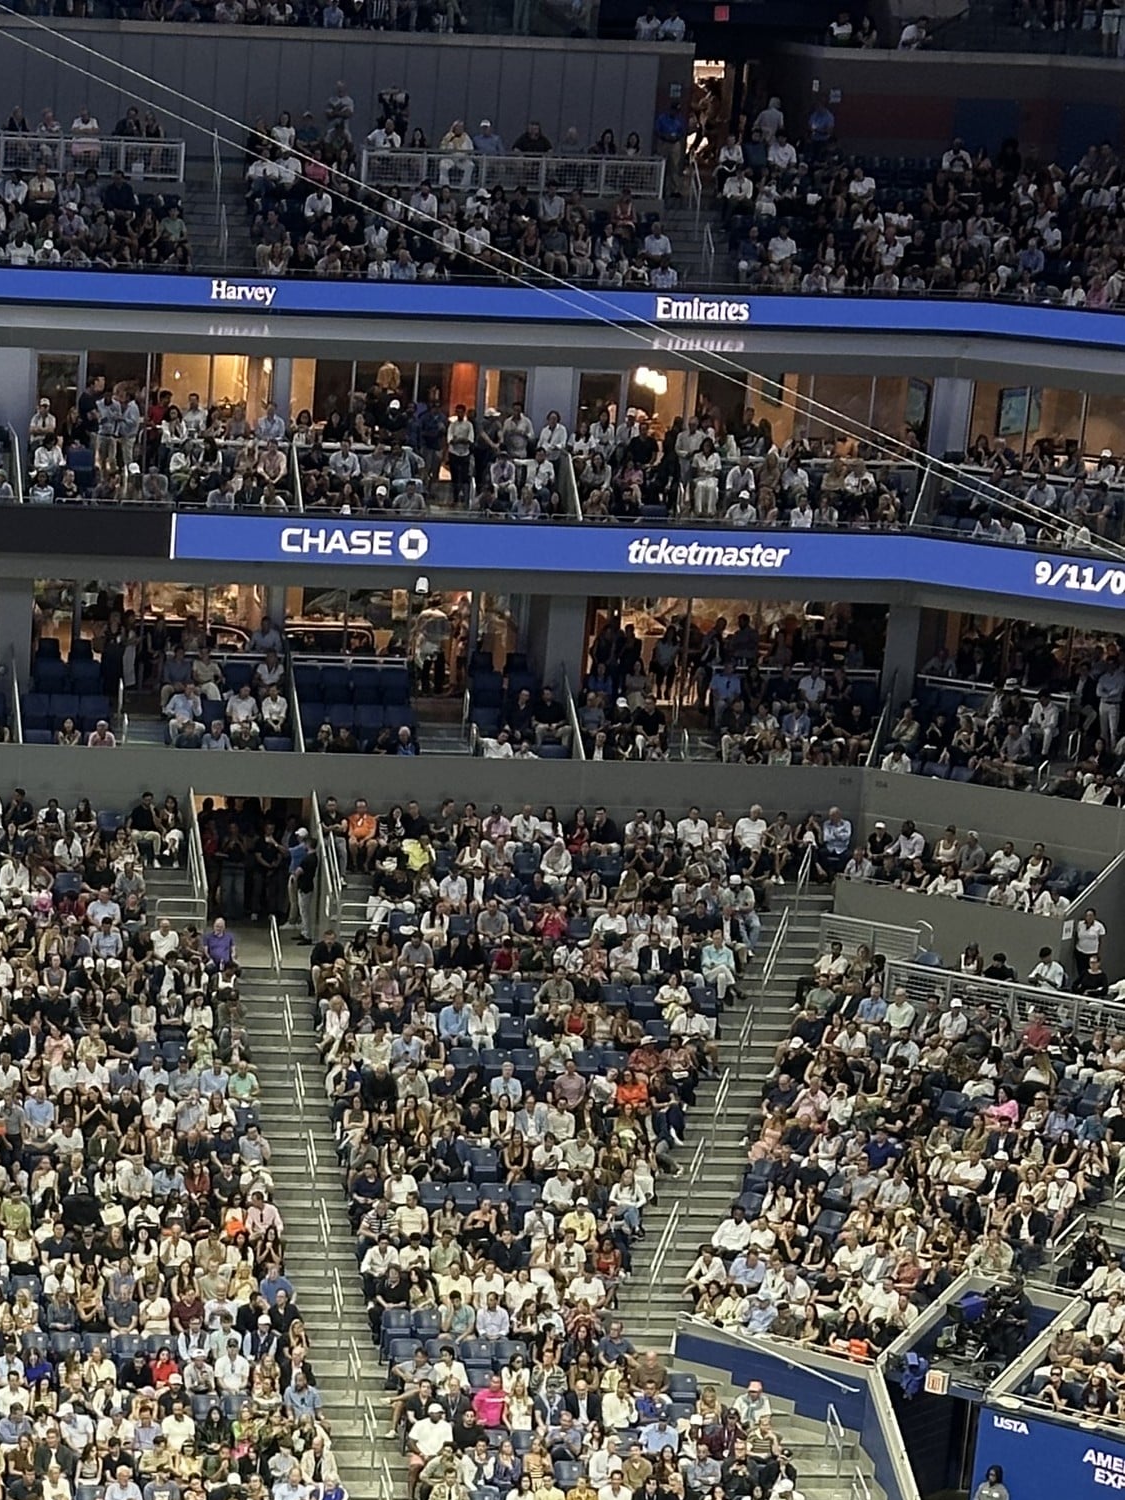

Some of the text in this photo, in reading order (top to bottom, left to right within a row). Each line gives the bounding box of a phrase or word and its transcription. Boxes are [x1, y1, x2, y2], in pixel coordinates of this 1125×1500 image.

[210, 279, 277, 306] Harvey
[656, 296, 750, 321] Emirates
[281, 527, 394, 555] CHASE
[628, 537, 790, 568] ticketmaster
[993, 1415, 1029, 1435] USTA
[1082, 1448, 1125, 1474] AME
